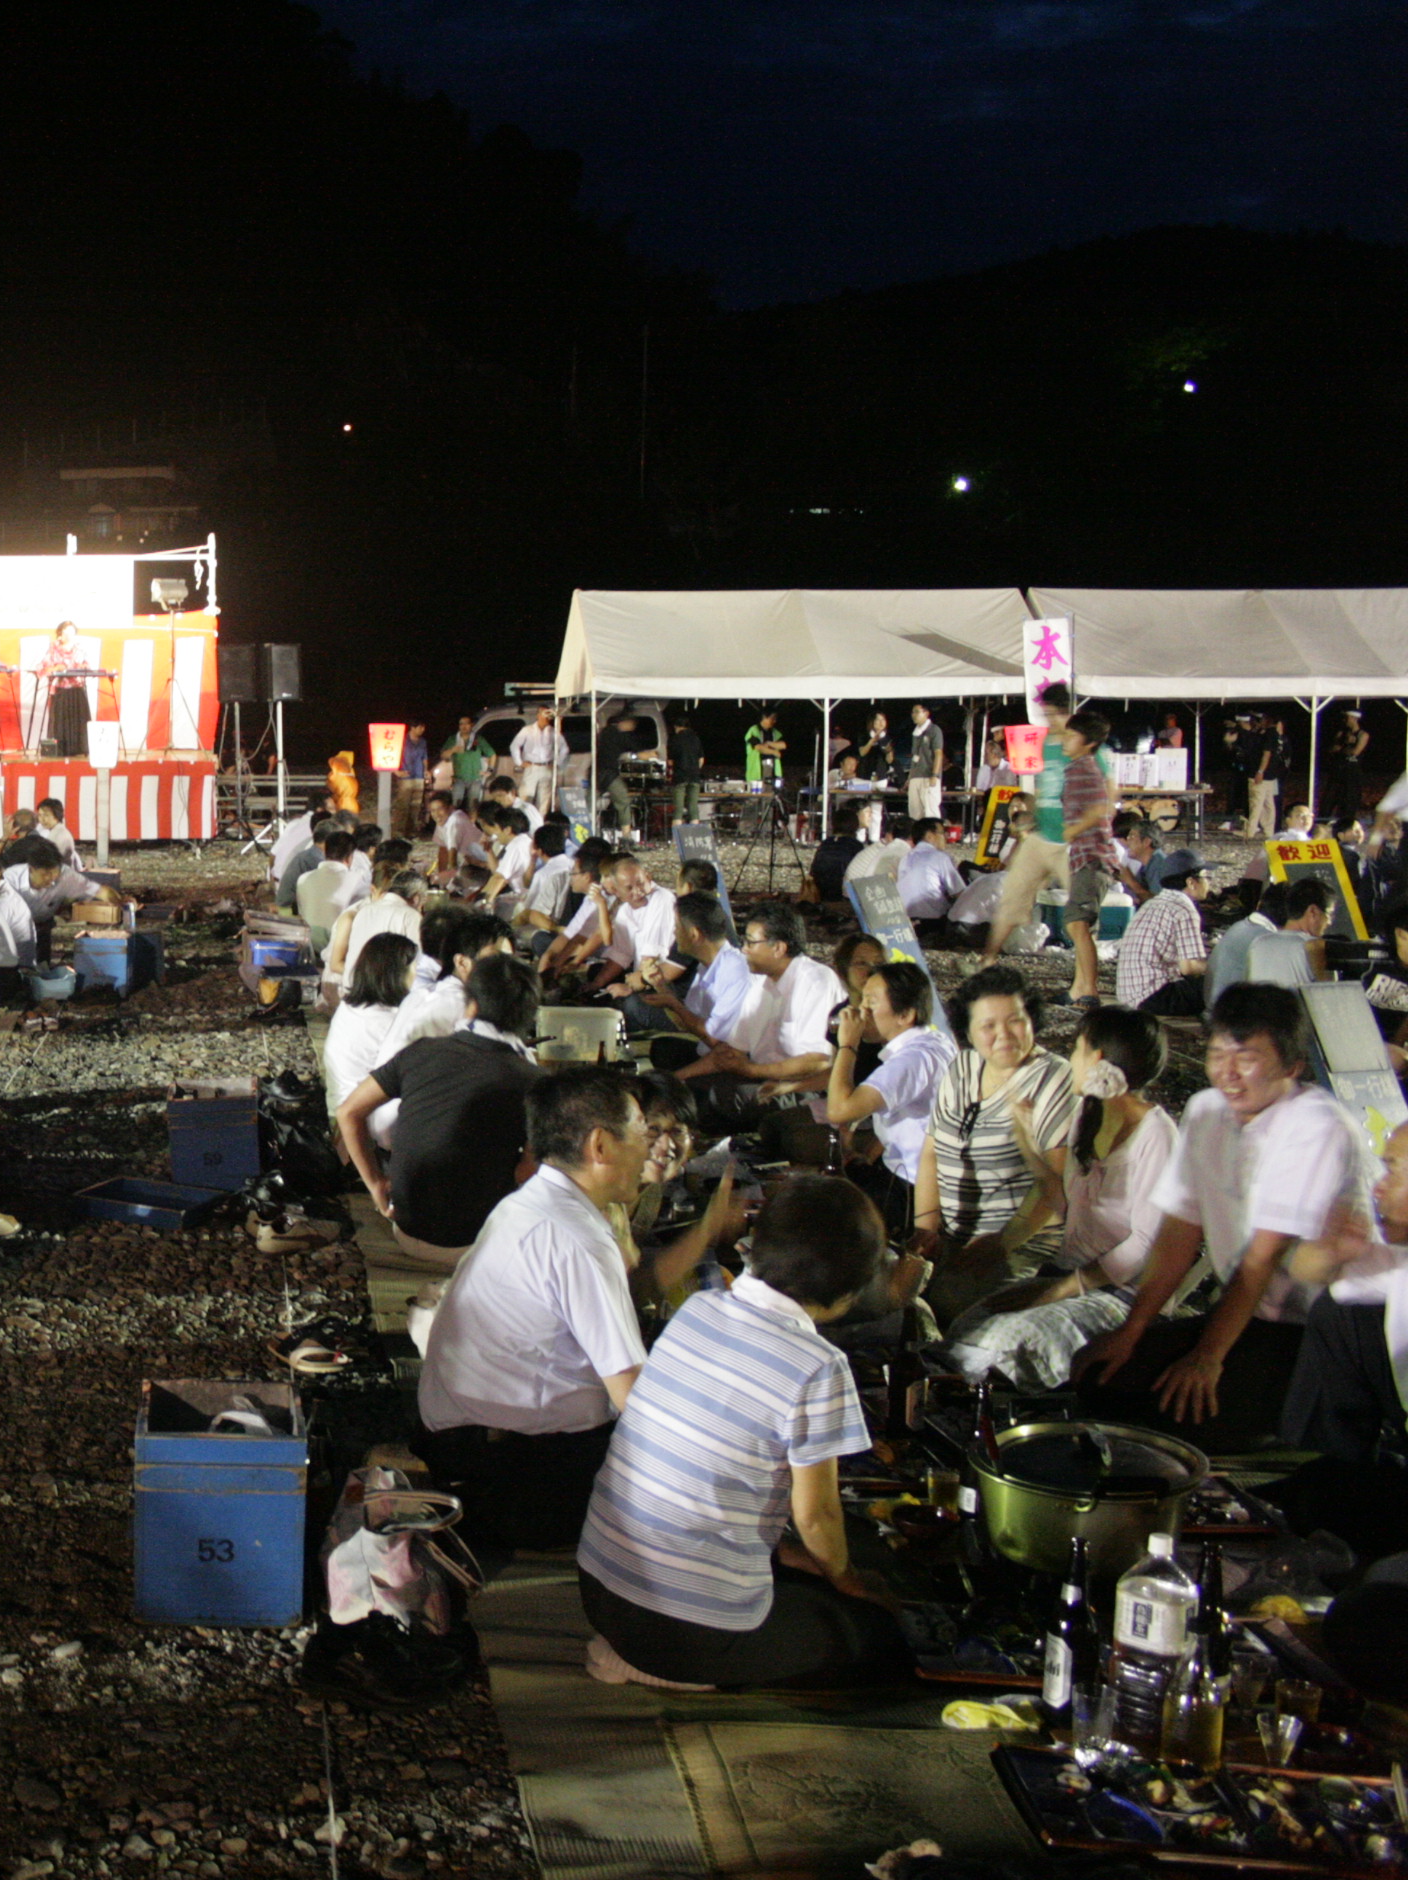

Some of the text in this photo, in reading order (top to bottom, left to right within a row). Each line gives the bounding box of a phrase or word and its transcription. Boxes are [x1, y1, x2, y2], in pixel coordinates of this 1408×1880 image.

[381, 728, 396, 766] むらや
[1276, 843, 1333, 861] 歓迎
[197, 1538, 235, 1563] 53
